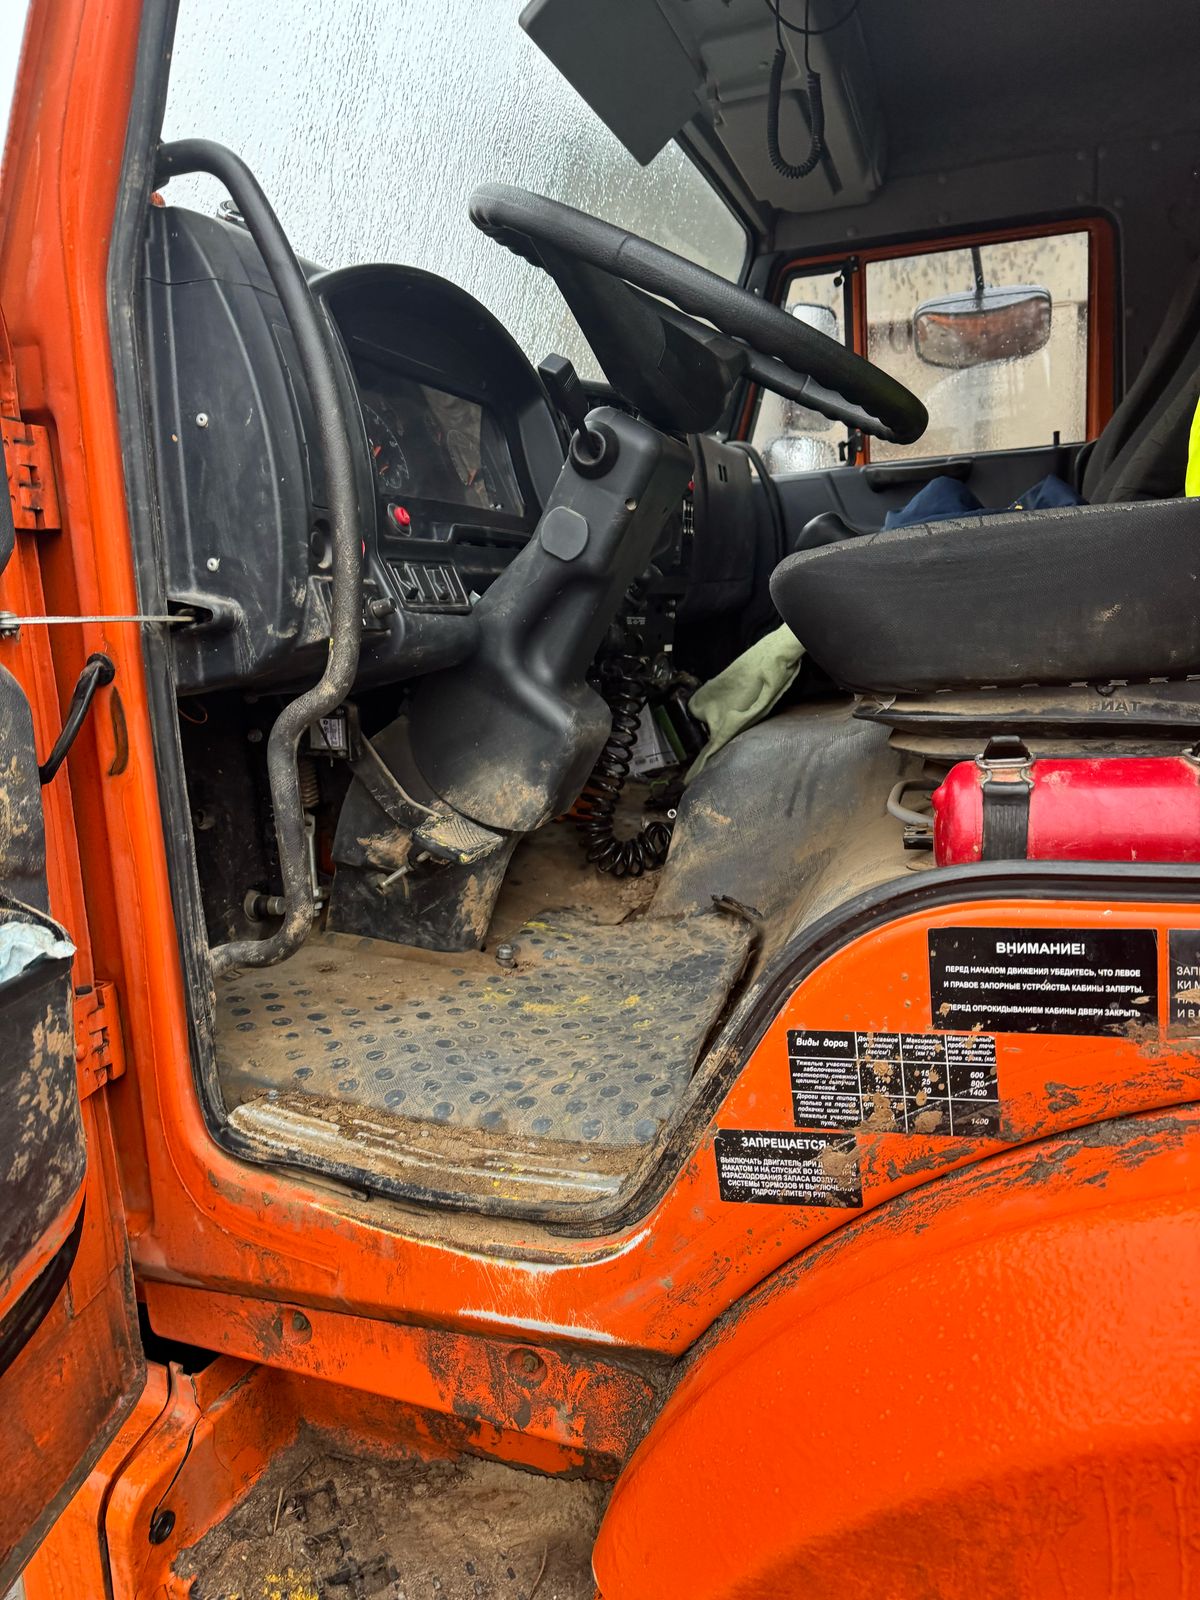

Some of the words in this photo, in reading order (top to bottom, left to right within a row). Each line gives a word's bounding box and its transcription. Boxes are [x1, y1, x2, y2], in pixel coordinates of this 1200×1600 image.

[996, 942, 1085, 955] ВНИМАНИЕ!
[945, 965, 969, 974] ПЕРЕД
[970, 966, 1006, 975] НАЧАЛОМ
[1007, 967, 1048, 976] ДВИЖЕНИЯ
[1050, 968, 1097, 977] УБЕДИТЕСЬ,
[1098, 969, 1114, 977] ЧТО
[1115, 969, 1141, 977] ЛЕВОЕ
[950, 981, 978, 989] ПРАВОЕ
[980, 982, 1020, 990] ЗАПОРНЫЕ
[1022, 983, 1070, 992] УСТРОЙСТВА
[1072, 985, 1104, 993] КАБИНЫ
[1105, 986, 1144, 994] ЗАПЕРТЫ.
[1177, 980, 1192, 989] КИ
[972, 1005, 1044, 1014] ОПРОКИДЫВАНИЕМ
[1045, 1007, 1077, 1015] КАБИНЫ
[1078, 1008, 1104, 1016] ДВЕРИ
[1105, 1009, 1141, 1018] ЗАКРЫТЬ
[1177, 1009, 1185, 1018] И
[796, 1037, 819, 1046] Виды
[823, 1038, 849, 1049] дорог
[720, 1156, 762, 1165] ВЫКЛЮЧАТЬ
[763, 1158, 801, 1167] ДВИГАТЕЛЬ
[722, 1164, 753, 1172] НАКАТОМ
[771, 1167, 801, 1175] СПУСКАХ
[722, 1172, 782, 1181] ИЗРАСХОДОВАНИЯ
[761, 1181, 798, 1189] ТОРМОЗОВ
